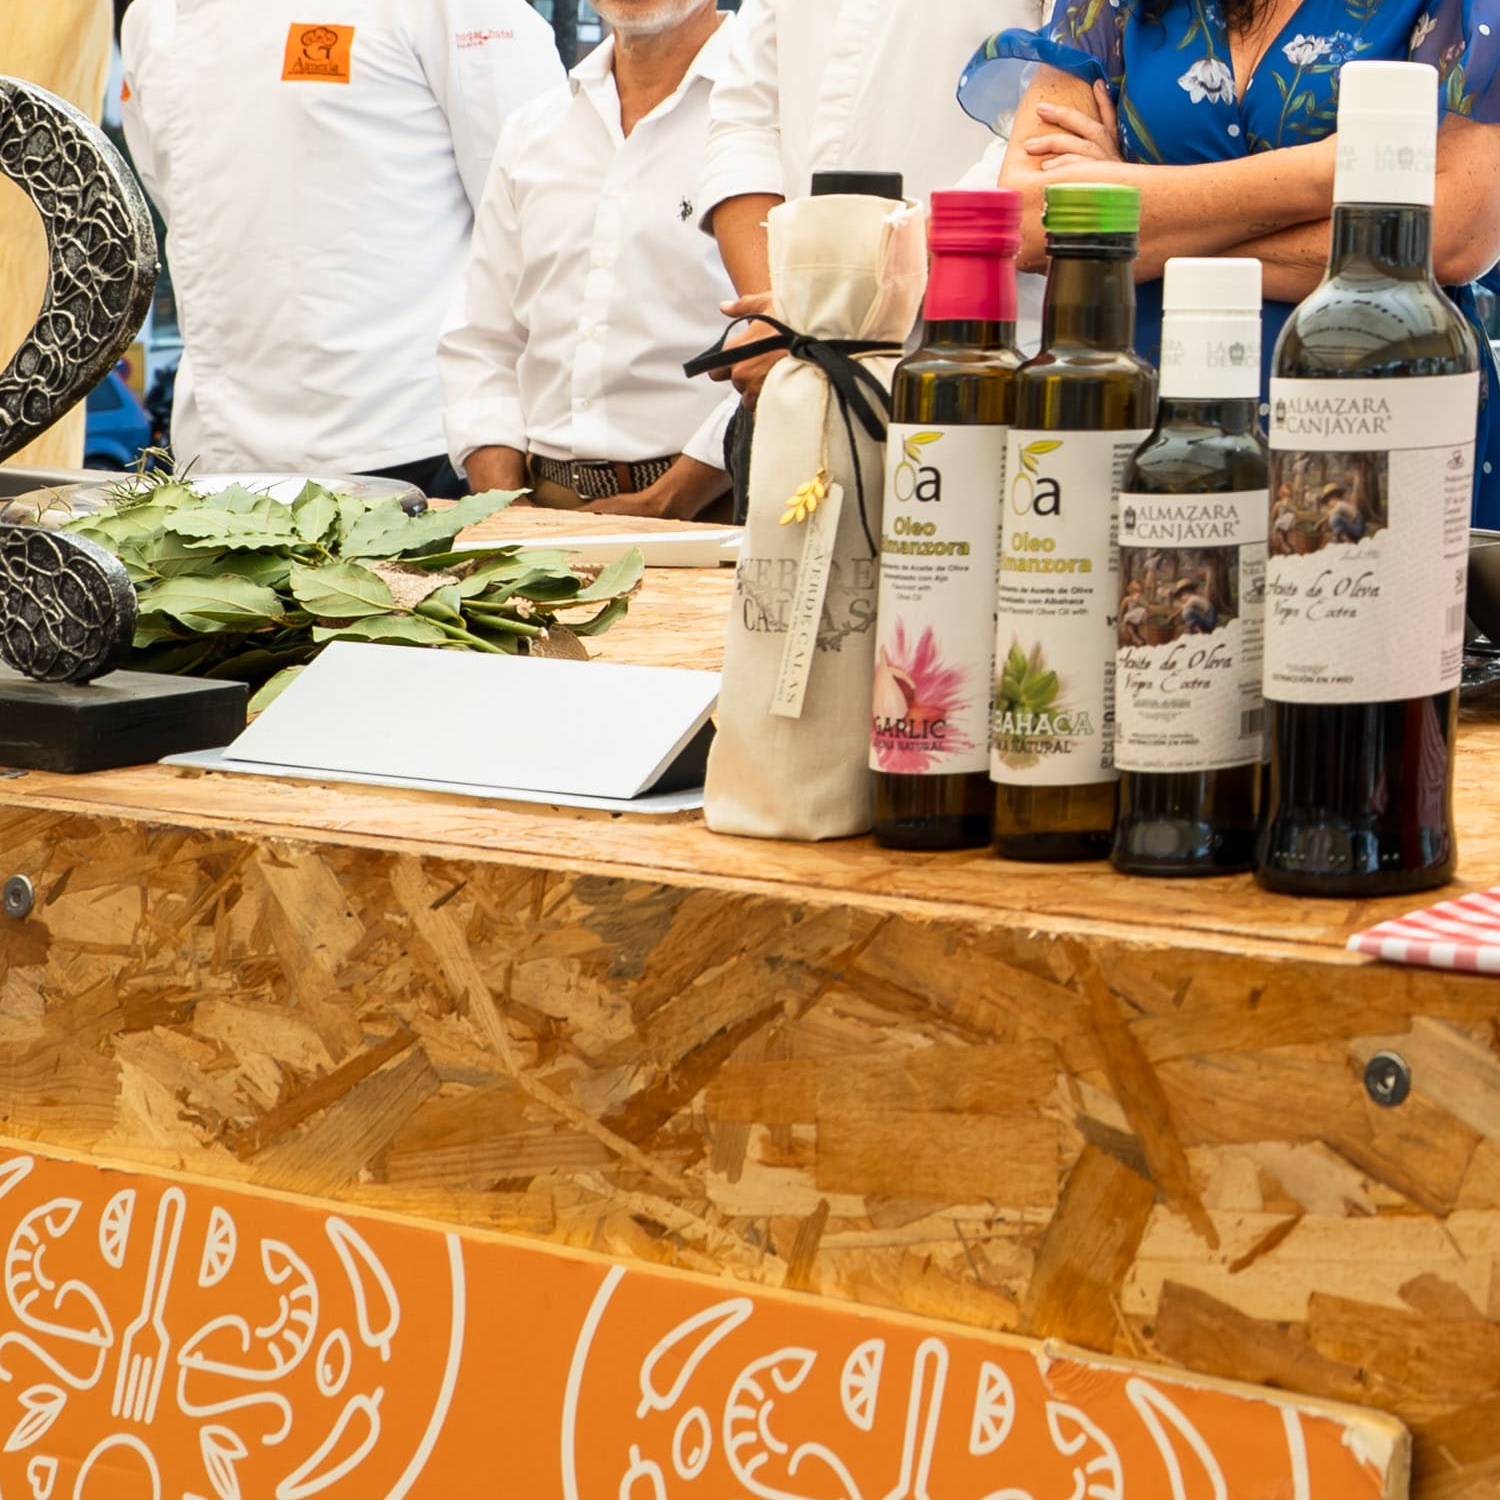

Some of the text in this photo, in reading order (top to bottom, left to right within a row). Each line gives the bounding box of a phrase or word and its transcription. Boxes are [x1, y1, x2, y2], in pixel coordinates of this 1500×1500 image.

[1288, 397, 1391, 415] ALMAZARA
[1137, 504, 1239, 522] ALMAZARA
[894, 516, 937, 537] Oleo
[1012, 531, 1056, 553] Oleo
[1333, 571, 1380, 598] Oliva
[1188, 644, 1233, 670] Oliva
[1012, 739, 1072, 754] NATURAL
